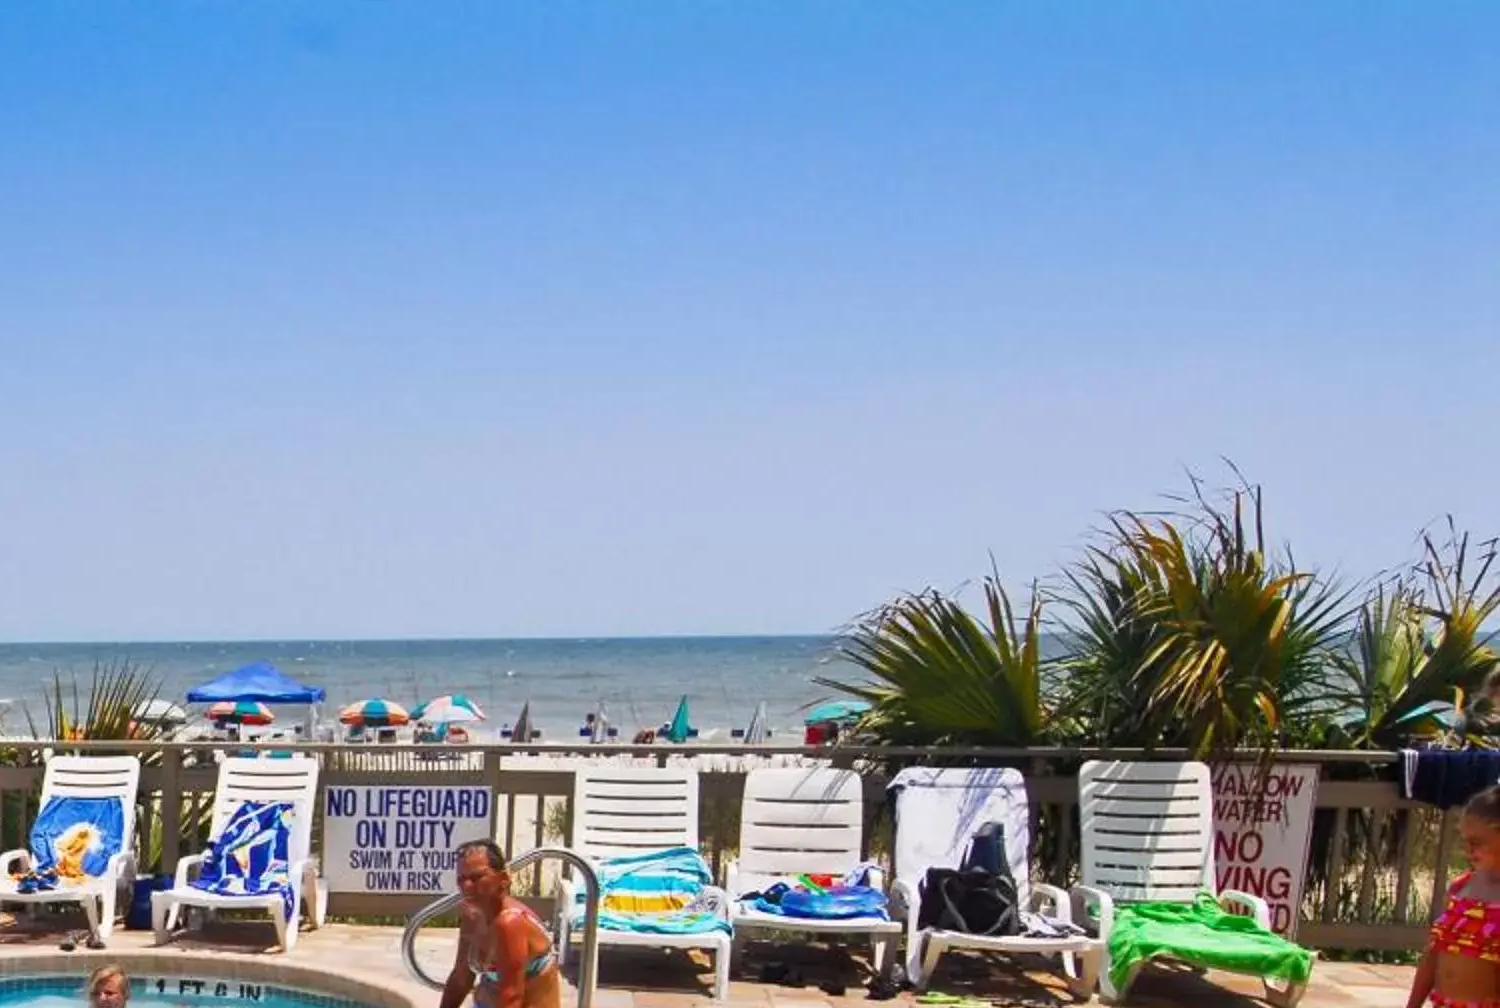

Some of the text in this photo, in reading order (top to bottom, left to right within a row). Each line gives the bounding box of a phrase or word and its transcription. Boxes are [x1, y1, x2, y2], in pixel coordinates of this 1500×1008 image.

[327, 789, 488, 818] NO LIFEGUARD
[356, 820, 455, 849] ON DUTY
[1214, 830, 1263, 863] NO
[350, 851, 392, 870] SWIM
[398, 851, 413, 870] AT
[366, 871, 443, 891] OWN RISK
[1215, 866, 1291, 900] VING
[180, 980, 205, 994] FT
[240, 984, 261, 1000] IN
